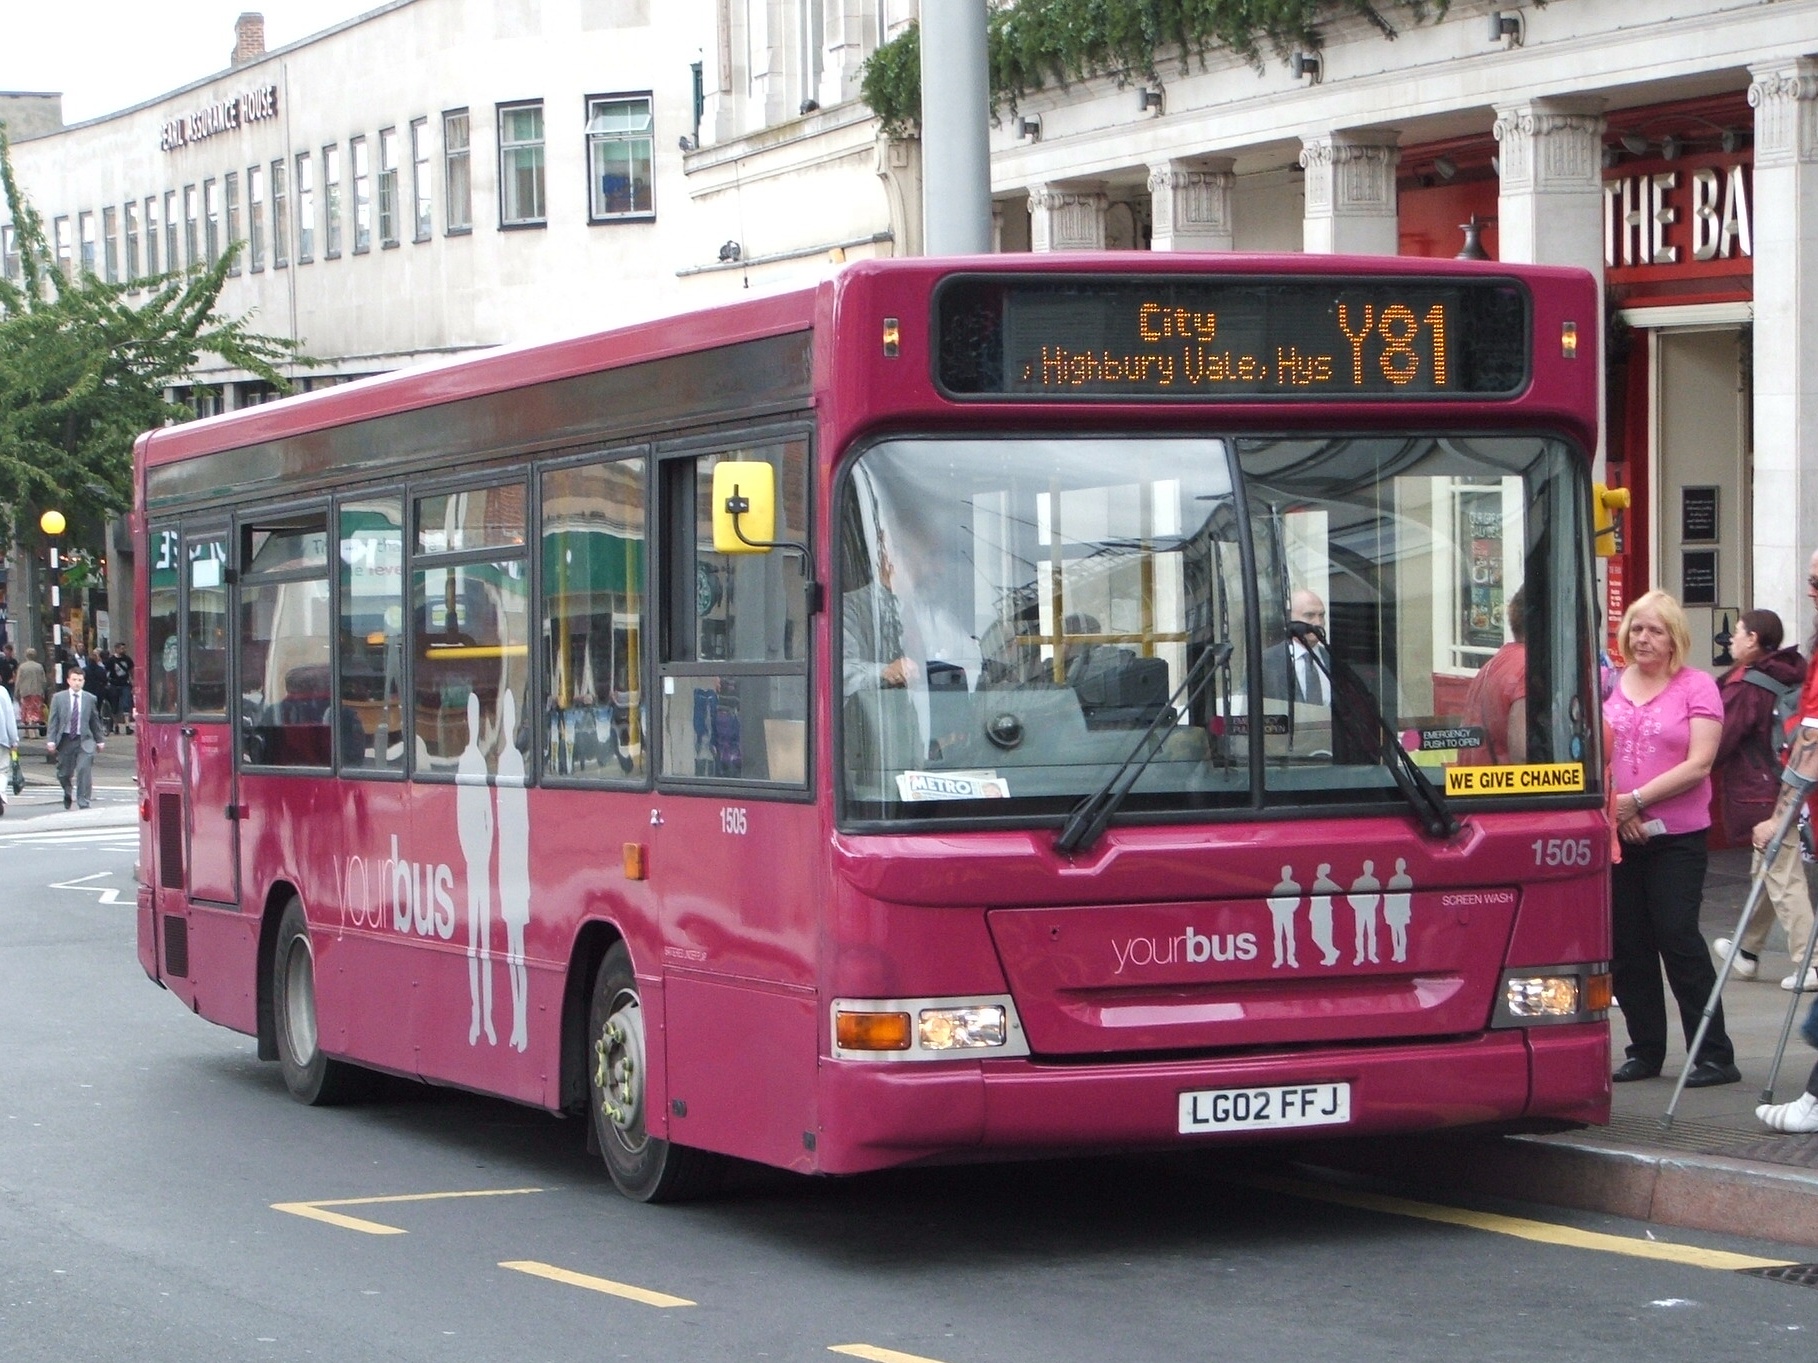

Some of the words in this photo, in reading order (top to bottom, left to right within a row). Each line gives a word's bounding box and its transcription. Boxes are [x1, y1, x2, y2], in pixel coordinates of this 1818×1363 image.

[158, 118, 186, 151] EARL
[188, 99, 239, 142] ASSURANCE
[243, 86, 277, 123] HOUSE
[1602, 172, 1676, 267] THE
[1692, 165, 1751, 261] BA
[1138, 303, 1217, 341] City
[1337, 304, 1446, 385] Y81
[1042, 346, 1174, 385] Highbury
[1184, 346, 1267, 385] Vale,
[1277, 346, 1333, 385] Hys
[1423, 729, 1472, 739] EMERGENCY
[1423, 738, 1445, 749] PUSH
[1446, 737, 1457, 748] TO
[1458, 736, 1480, 747] OPEN
[910, 775, 973, 795] METRO
[1450, 773, 1473, 789] WE
[1480, 771, 1514, 788] GIVE
[1520, 769, 1580, 786] CHANGE
[720, 806, 748, 835] 1505
[1531, 839, 1592, 866] 1505
[1442, 895, 1482, 906] SCREEN
[1483, 893, 1514, 904] WASH
[1192, 1091, 1271, 1125] LG02
[1281, 1086, 1338, 1119] FFJ
